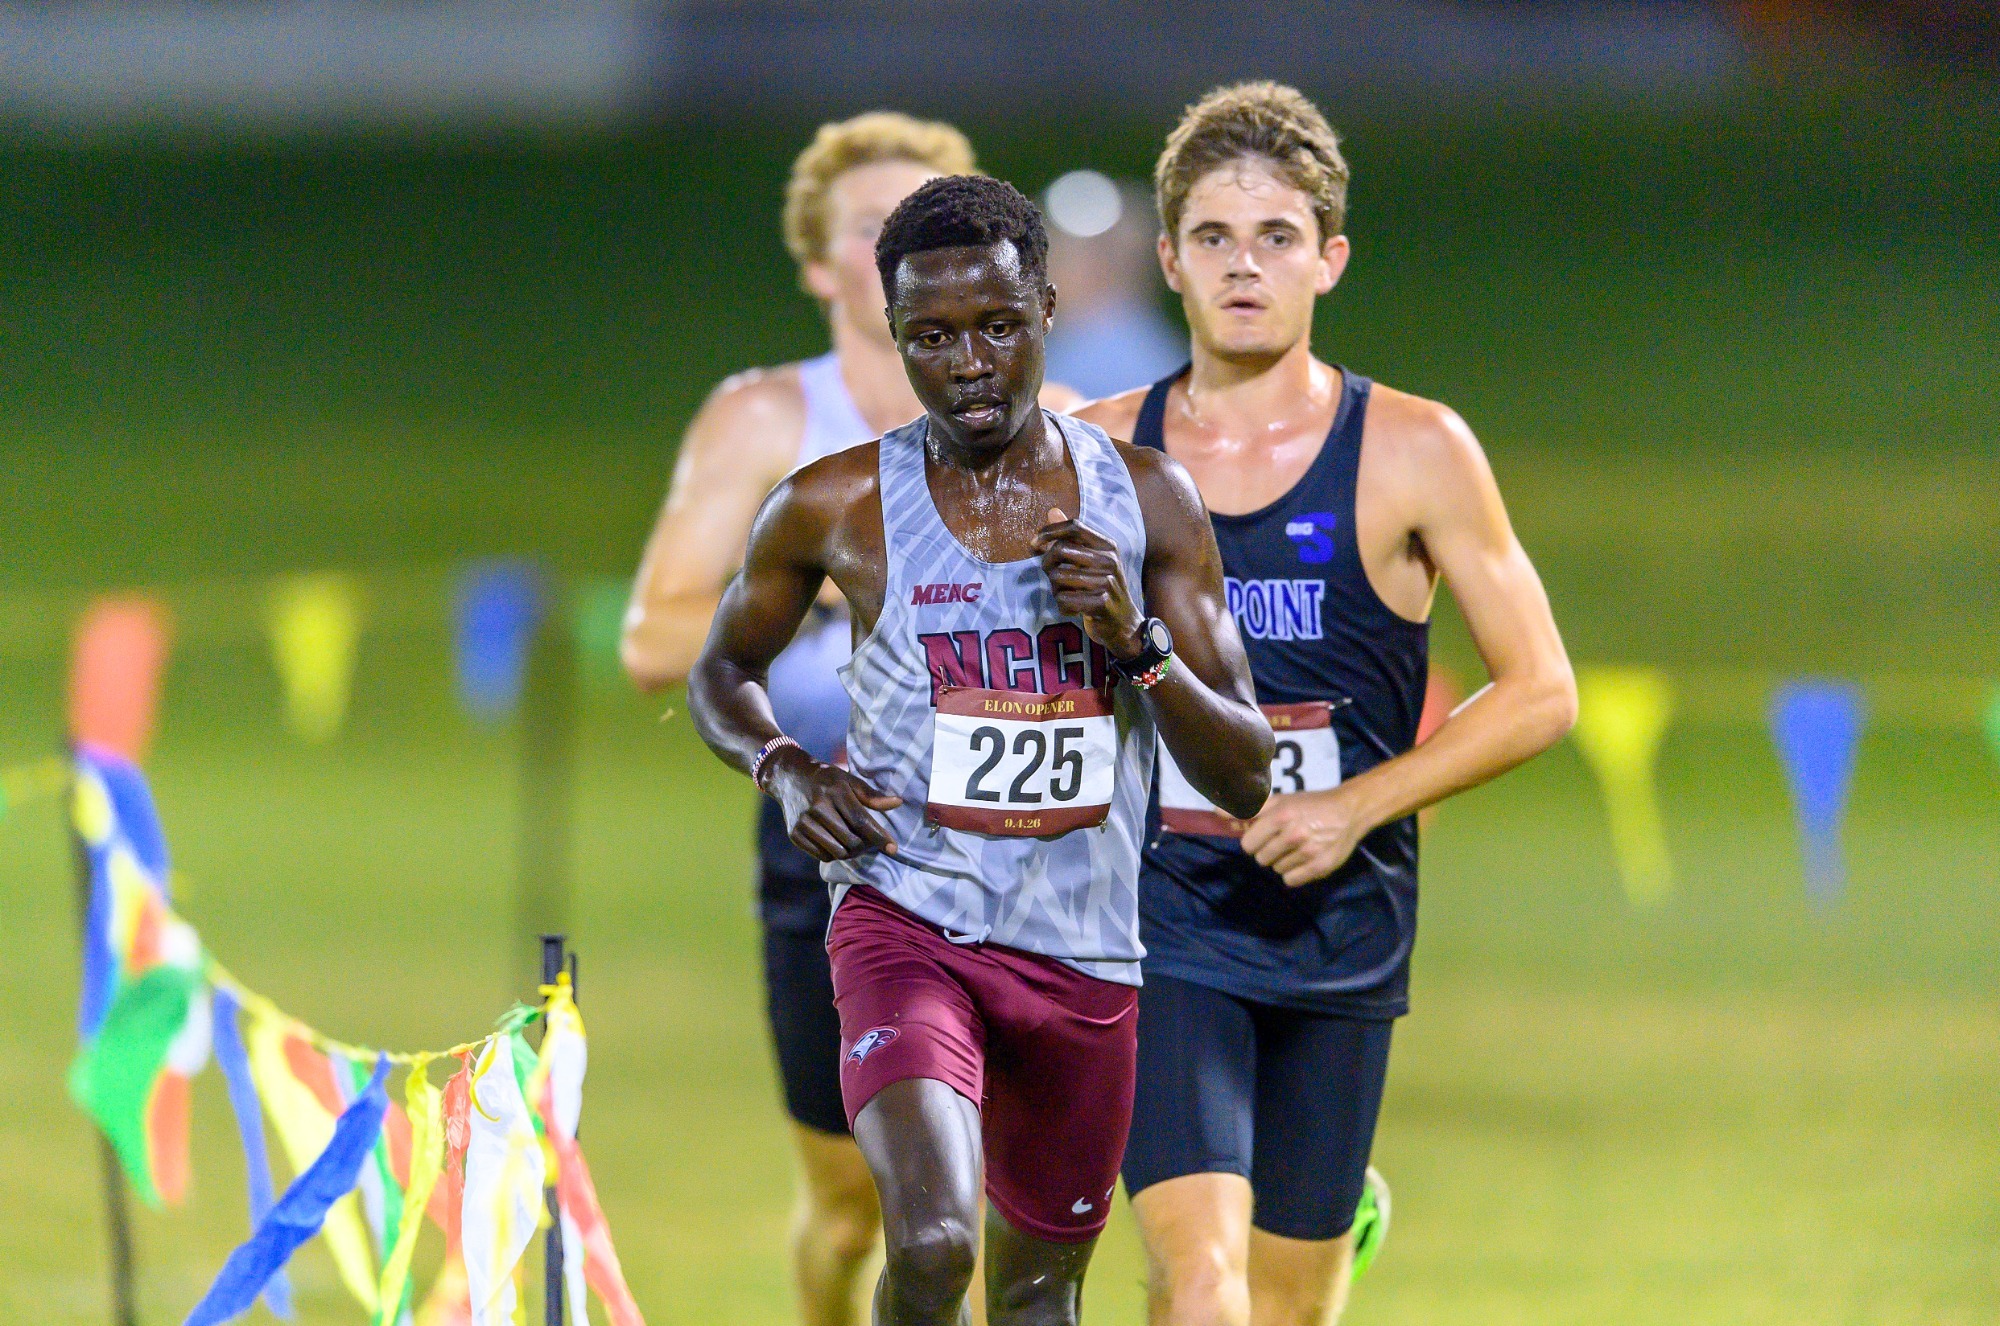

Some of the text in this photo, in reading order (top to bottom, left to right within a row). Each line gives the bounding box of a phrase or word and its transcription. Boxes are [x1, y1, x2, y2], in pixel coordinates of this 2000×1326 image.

[910, 582, 982, 607] MEAC
[1224, 576, 1325, 641] POINT
[984, 699, 1075, 715] ELON OPENER
[965, 725, 1083, 803] 225
